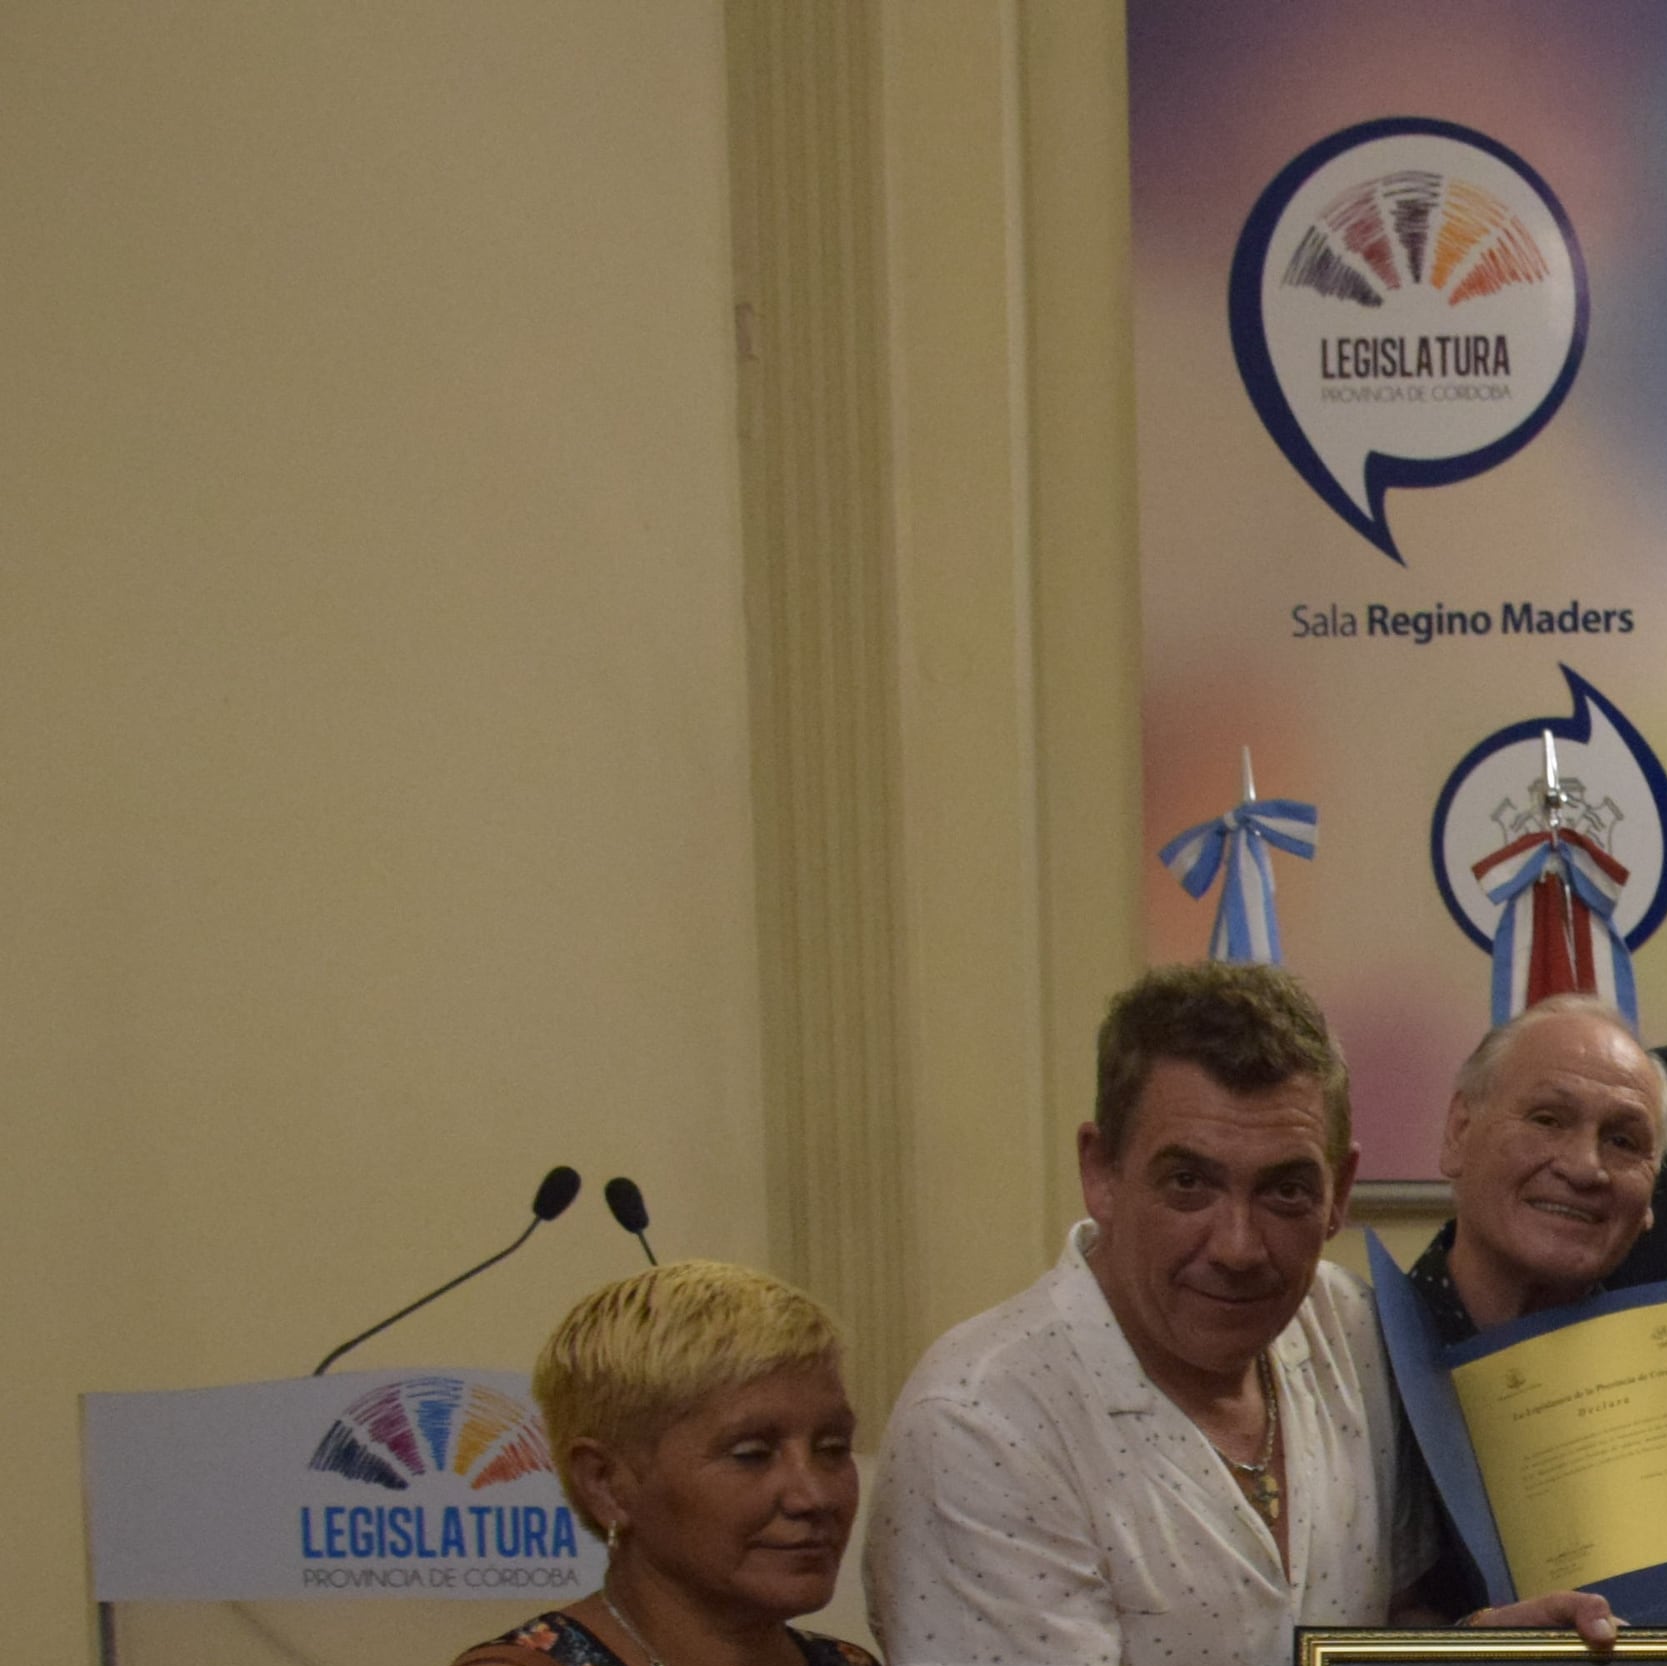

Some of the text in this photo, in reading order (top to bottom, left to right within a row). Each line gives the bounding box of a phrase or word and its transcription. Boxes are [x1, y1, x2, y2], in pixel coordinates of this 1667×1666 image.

[1320, 335, 1511, 379] LEGISLATURA
[1320, 384, 1404, 403] PROVINCIA
[1408, 384, 1428, 402] DE
[1291, 601, 1635, 644] Sala Regino Maders
[1578, 1396, 1630, 1417] Declara
[299, 1505, 578, 1559] LEGISLATURA
[303, 1563, 579, 1588] PROVINCIA DE CÓRDOBA
